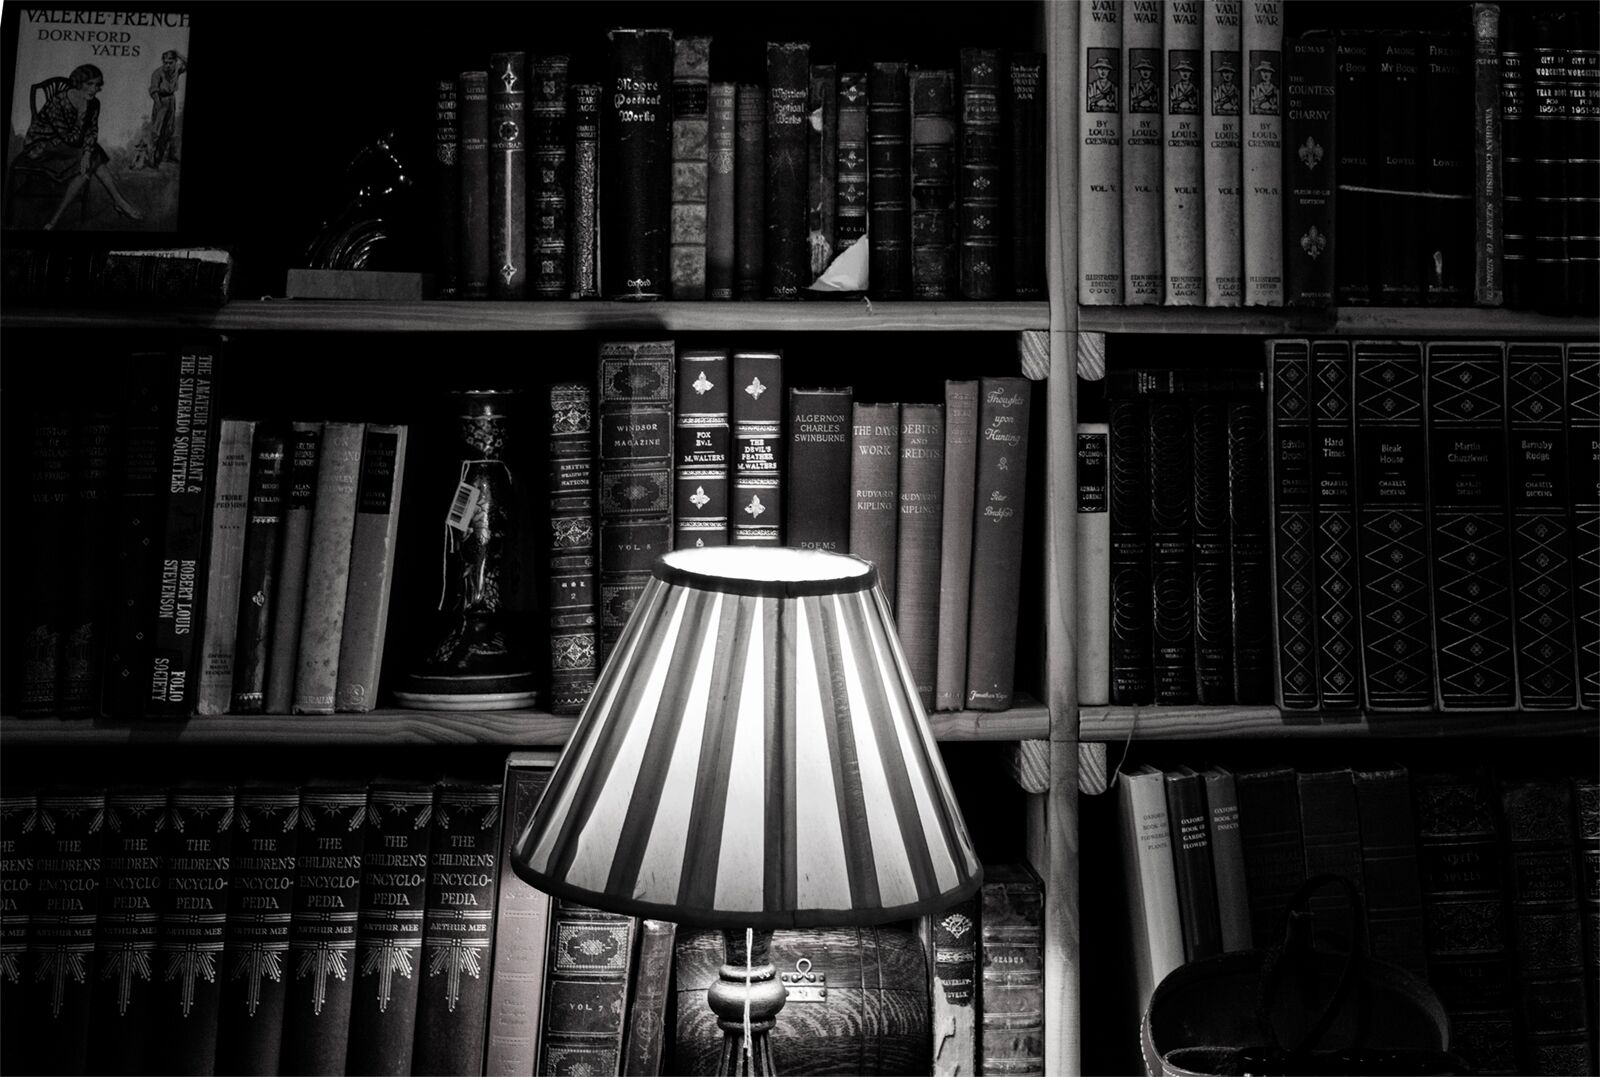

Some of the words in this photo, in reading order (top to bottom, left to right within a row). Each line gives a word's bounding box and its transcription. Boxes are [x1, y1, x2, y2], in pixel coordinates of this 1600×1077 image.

[1091, 0, 1116, 10] VAAL
[1134, 1, 1158, 11] VAAL
[1173, 2, 1199, 12] VAAL
[1215, 3, 1240, 14] VAAL
[1255, 3, 1279, 13] VAAL
[27, 9, 106, 25] VALERIE
[110, 11, 190, 28] FRENCH
[1091, 12, 1117, 23] WAR
[1133, 13, 1158, 24] WAR
[1172, 14, 1198, 25] WAR
[1215, 15, 1239, 26] WAR
[1254, 14, 1278, 25] WAR
[38, 29, 131, 43] DORNFORD
[92, 45, 141, 57] YATES
[1540, 56, 1555, 65] CITY
[1571, 57, 1586, 66] CITY
[1288, 86, 1335, 96] COUNTESS
[1536, 89, 1552, 97] YEAR
[1570, 90, 1586, 98] YEAR
[1289, 110, 1330, 120] CHARNY
[1096, 120, 1108, 128] BY
[1140, 120, 1151, 128] BY
[1179, 122, 1191, 130] BY
[1222, 123, 1233, 131] BY
[1260, 122, 1271, 130] BY
[1089, 129, 1115, 137] LOUIS
[1132, 129, 1158, 137] LOUIS
[1171, 131, 1198, 139] LOUIS
[1214, 132, 1240, 140] LOUIS
[1252, 131, 1277, 139] LOUIS
[181, 354, 196, 375] THE
[198, 354, 213, 375] THE
[192, 377, 211, 426] AMATEUR
[986, 387, 1024, 408] Thoughts
[175, 377, 194, 434] SILVERADO
[795, 414, 845, 423] ALGERNON
[992, 416, 1014, 427] upon
[616, 423, 659, 433] WINDSOR
[800, 424, 840, 433] CHARLES
[853, 425, 873, 436] THE
[697, 431, 712, 440] FOX
[794, 434, 846, 443] SWINBURNE
[984, 428, 1020, 447] Hunting
[614, 438, 661, 447] MAGAZINE
[1324, 437, 1344, 447] Hard
[1454, 441, 1482, 451] Martin
[1520, 440, 1553, 451] Barnaby
[744, 446, 772, 454] DEVIL'S
[859, 445, 892, 456] WORK
[1322, 448, 1347, 458] Times
[1381, 443, 1402, 453] Bleak
[188, 428, 207, 482] EMIGRANT
[1380, 455, 1405, 464] House
[1525, 451, 1551, 463] Rudge
[170, 436, 189, 494] SQUATTERS
[187, 485, 203, 494] &
[857, 490, 895, 499] RUDYARD
[857, 502, 892, 511] KIPLING
[618, 543, 643, 552] VOL
[801, 541, 836, 550] POEMS
[178, 559, 196, 600] ROBERT
[159, 559, 179, 619] STEVENSON
[175, 602, 193, 635] LOUIS
[152, 657, 170, 702] SOCIETY
[168, 670, 186, 703] FOLIO
[1180, 816, 1205, 825] OXFORD
[1213, 815, 1230, 823] BOOK
[1181, 825, 1198, 833] BOOK
[384, 835, 408, 848] THE
[450, 835, 476, 848] THE
[1182, 832, 1206, 842] GARDEN
[57, 839, 81, 852] THE
[123, 838, 148, 850] THE
[187, 839, 211, 851] THE
[252, 839, 277, 851] THE
[317, 837, 343, 850] THE
[298, 855, 361, 869] CHILDREN'S
[364, 853, 427, 867] CHILDREN'S
[432, 853, 494, 867] CHILDREN'S
[299, 876, 360, 889] ENCYCLO-
[366, 873, 425, 887] ENCYCLO-
[433, 873, 493, 887] ENCYCLO-
[48, 898, 84, 910] PEDIA
[114, 896, 152, 909] PEDIA
[176, 897, 214, 909] PEDIA
[242, 896, 280, 909] PEDIA
[307, 895, 345, 908] PEDIA
[373, 892, 411, 906] PEDIA
[440, 892, 479, 906] PEDIA
[270, 927, 288, 935] MEE
[335, 926, 354, 934] MEE
[400, 923, 420, 932] MEE
[431, 922, 466, 931] ARTHUR
[468, 923, 487, 932] MEE
[569, 1003, 593, 1011] VOL
